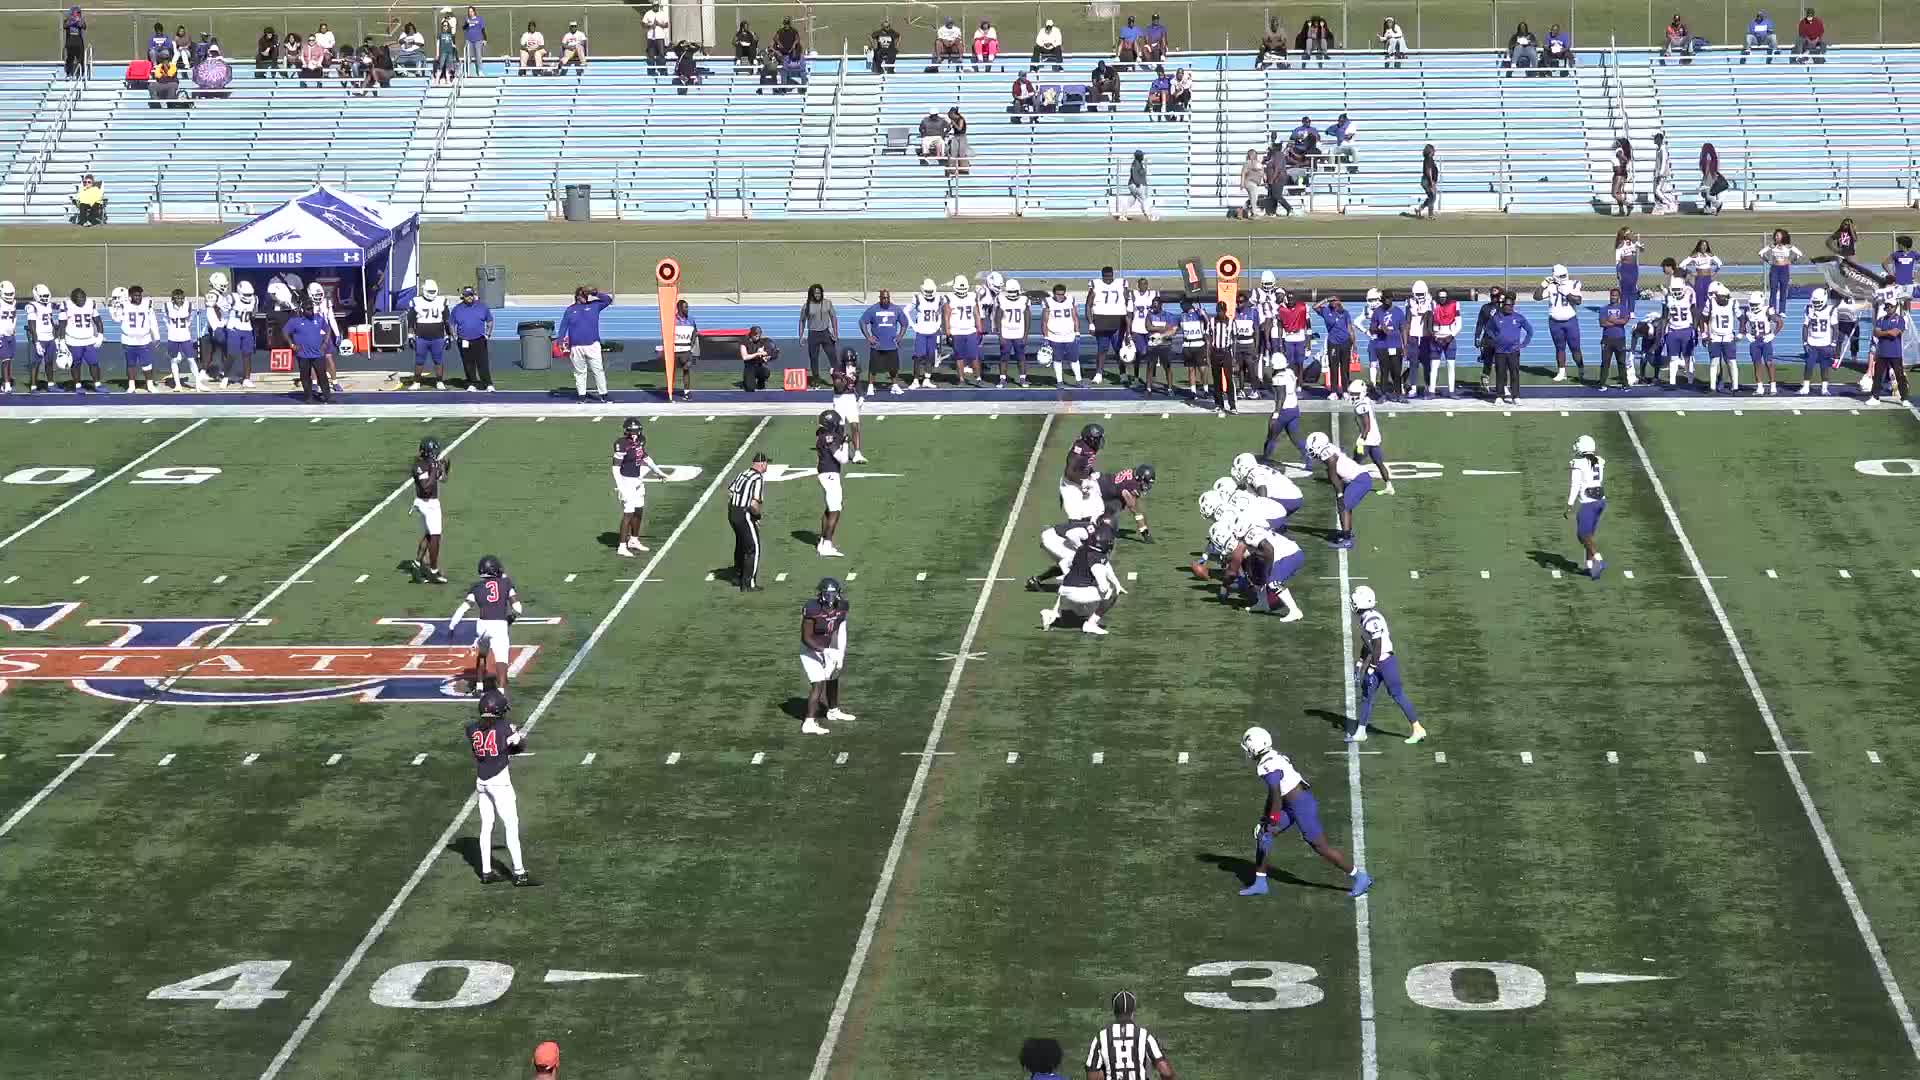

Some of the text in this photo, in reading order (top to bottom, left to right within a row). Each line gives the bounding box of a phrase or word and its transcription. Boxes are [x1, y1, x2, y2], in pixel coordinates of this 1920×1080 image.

[256, 252, 303, 265] VIKINGS
[1102, 290, 1119, 304] 77
[73, 313, 92, 328] 95
[128, 311, 146, 328] 97
[1005, 308, 1022, 323] 70
[1715, 314, 1730, 329] 12
[270, 352, 291, 370] 50
[786, 370, 804, 387] 40
[485, 580, 501, 603] 3
[0, 651, 466, 674] STATE
[471, 729, 499, 757] 24
[1112, 1039, 1136, 1069] H
